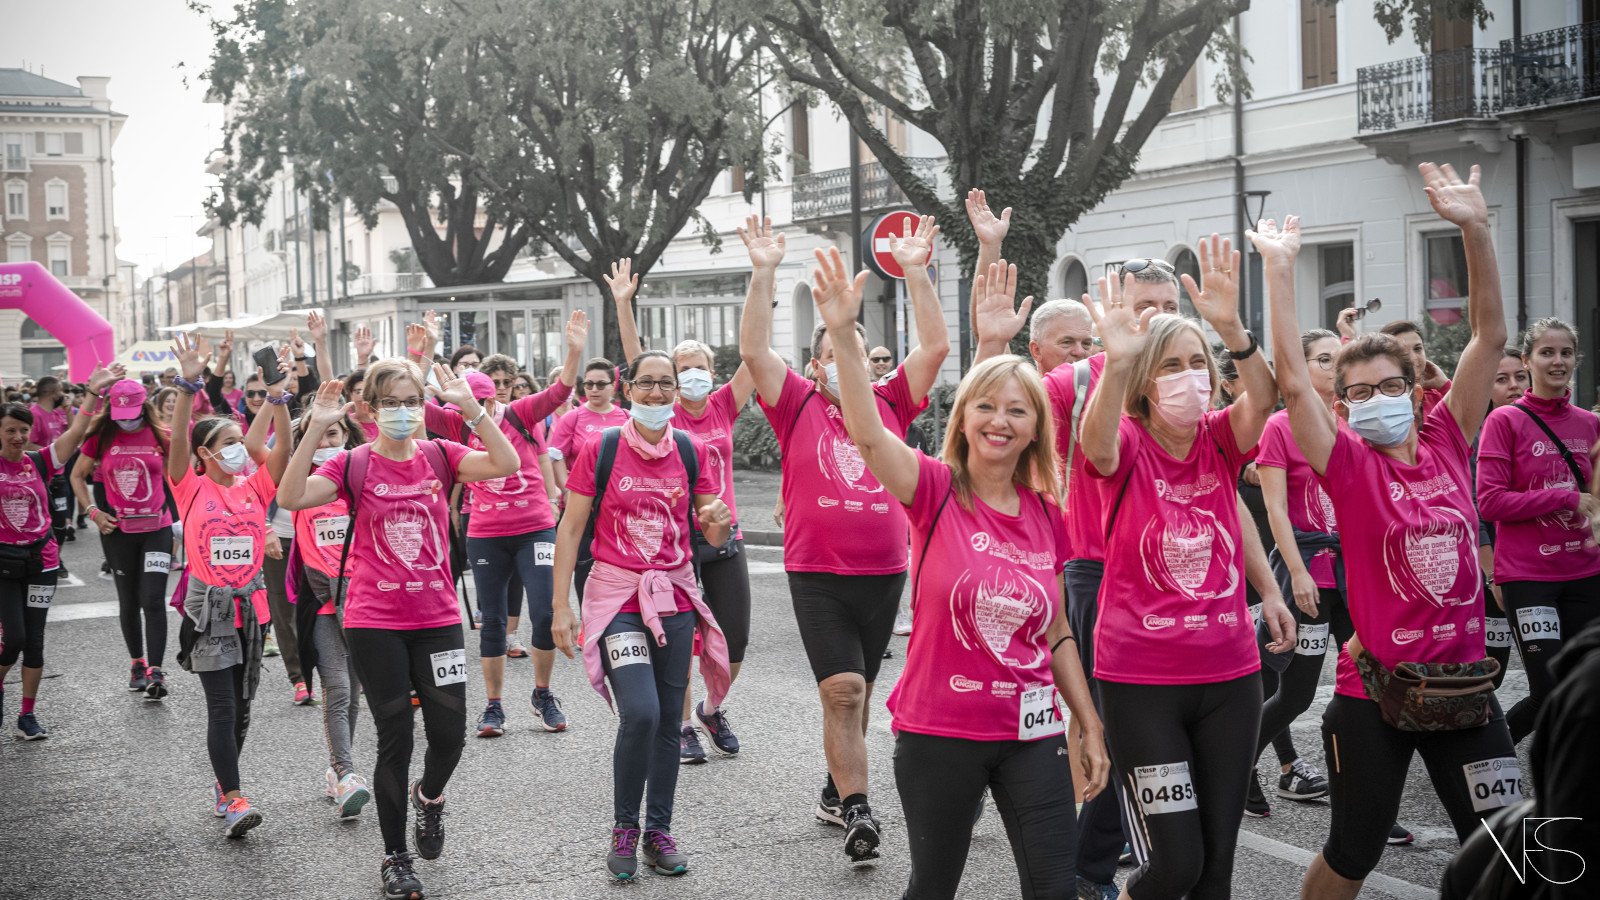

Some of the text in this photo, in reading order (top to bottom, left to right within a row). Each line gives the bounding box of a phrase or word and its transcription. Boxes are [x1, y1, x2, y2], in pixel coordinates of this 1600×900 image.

[131, 351, 175, 362] AVI
[319, 530, 345, 541] 105
[214, 550, 251, 560] 1054
[538, 552, 552, 560] 04
[30, 594, 53, 604] 033
[1521, 621, 1558, 635] 0034
[1486, 630, 1512, 642] 037
[611, 646, 648, 661] 0480
[437, 663, 467, 678] 047
[1024, 708, 1060, 730] 047
[1142, 783, 1193, 804] 0485
